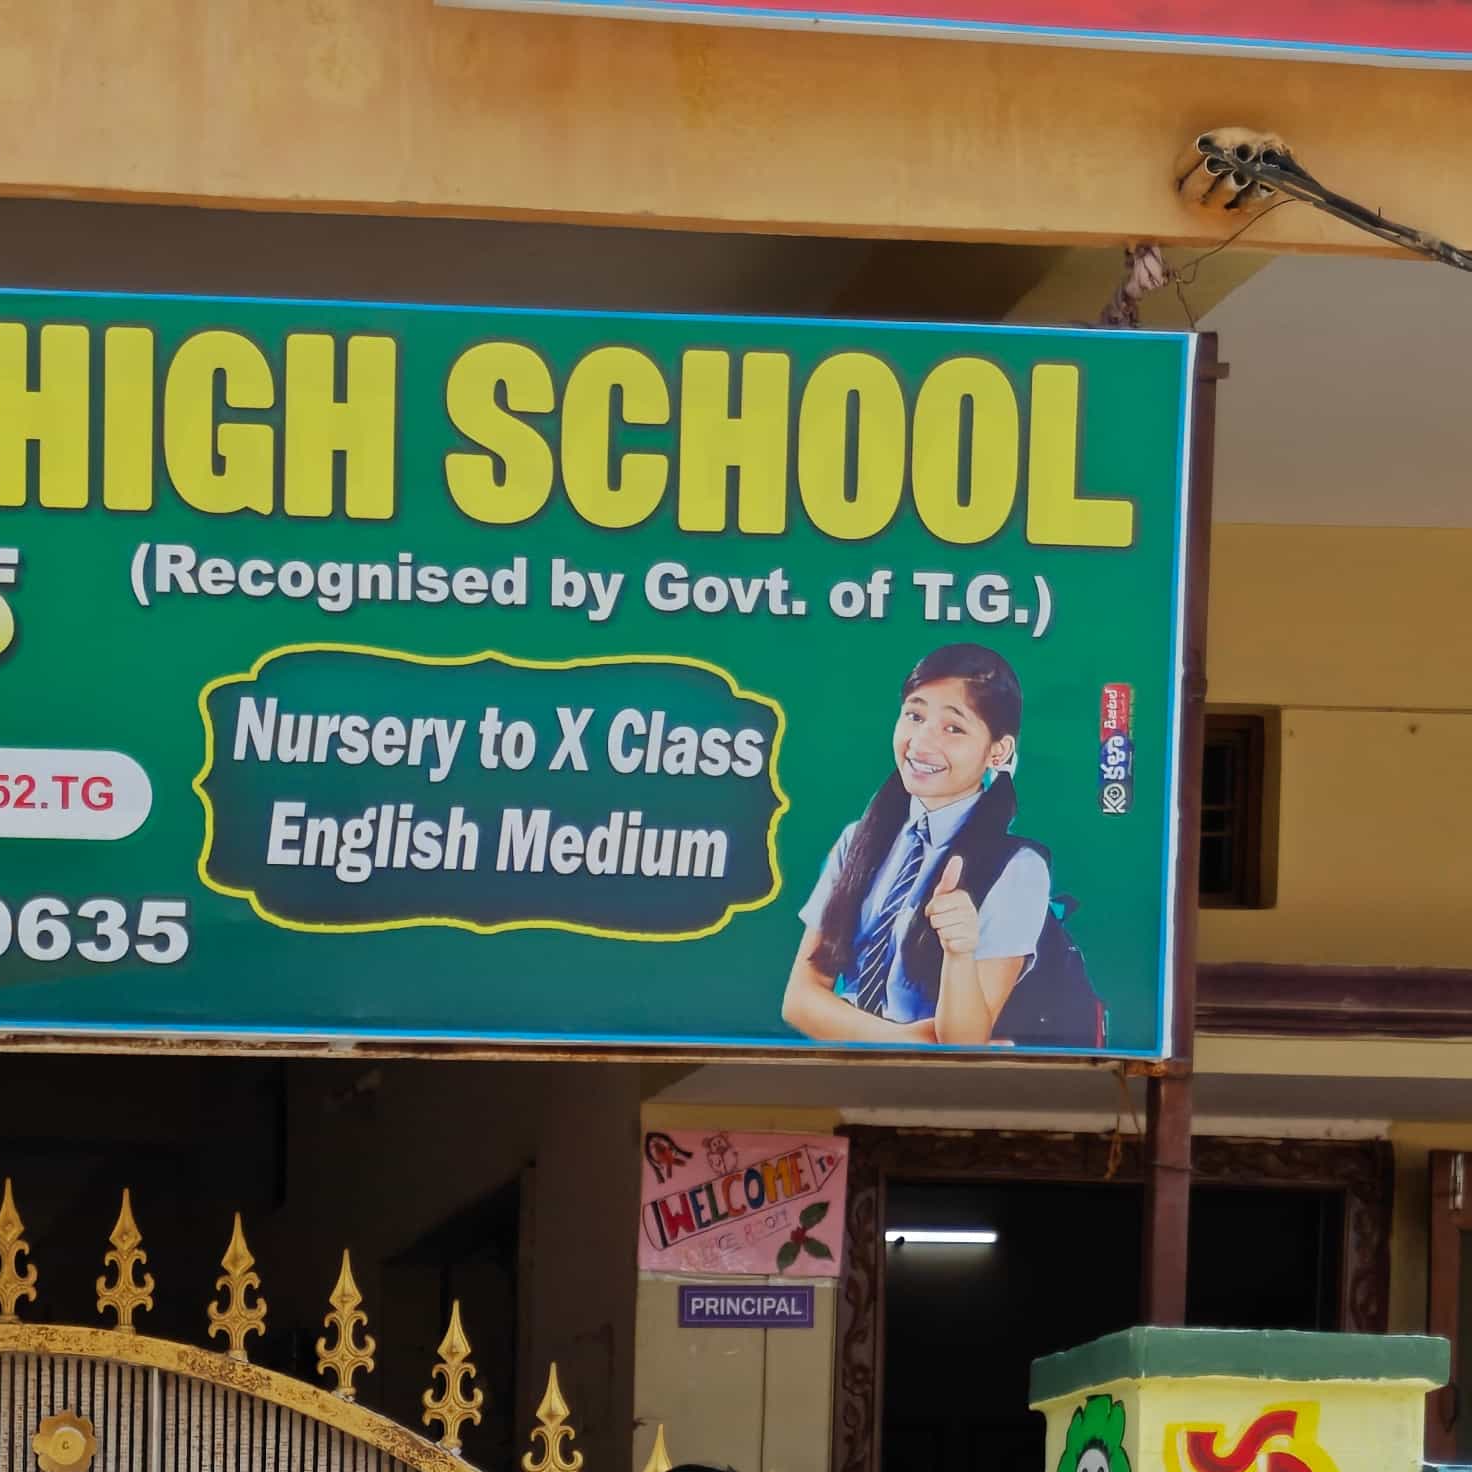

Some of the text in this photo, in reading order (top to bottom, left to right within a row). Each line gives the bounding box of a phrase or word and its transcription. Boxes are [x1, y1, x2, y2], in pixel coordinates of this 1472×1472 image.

[444, 340, 1134, 548] SCHOOL
[130, 541, 1055, 636] (Recognised by Govt. of T.G.)
[232, 695, 765, 783] Nursery to X Class
[266, 801, 727, 883] English Medium
[659, 1152, 810, 1241] WELCOME
[691, 1297, 802, 1316] PRINCIPAL
